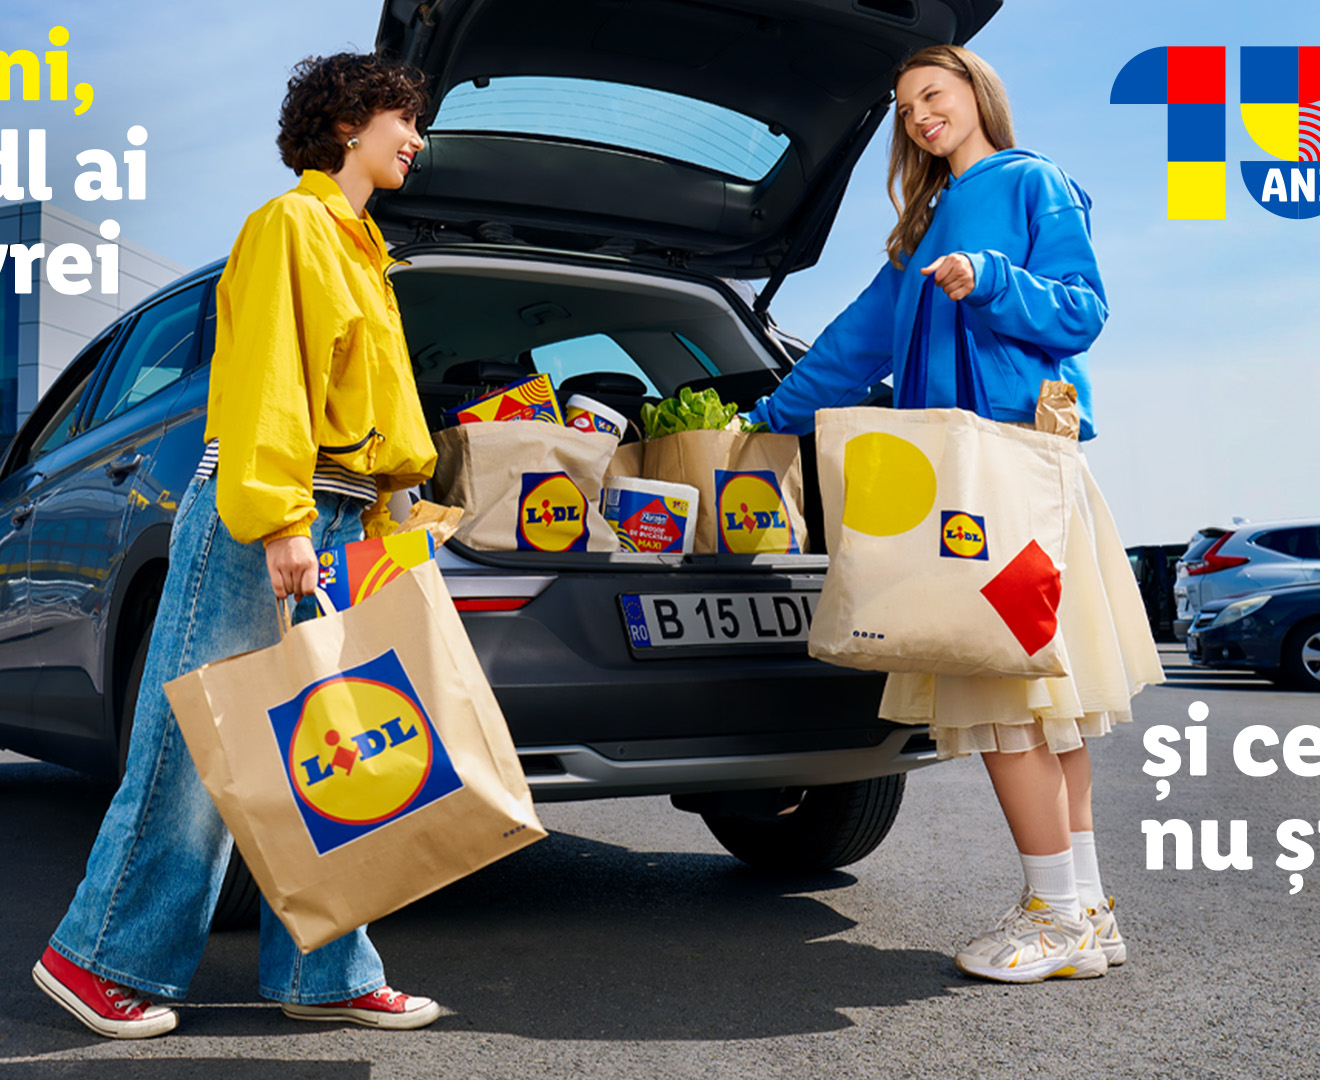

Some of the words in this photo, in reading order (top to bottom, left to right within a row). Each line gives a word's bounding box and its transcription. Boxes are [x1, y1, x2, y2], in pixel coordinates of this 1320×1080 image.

[638, 539, 661, 549] MAXI
[653, 599, 685, 640] B
[695, 597, 740, 639] 15
[630, 624, 648, 642] RO
